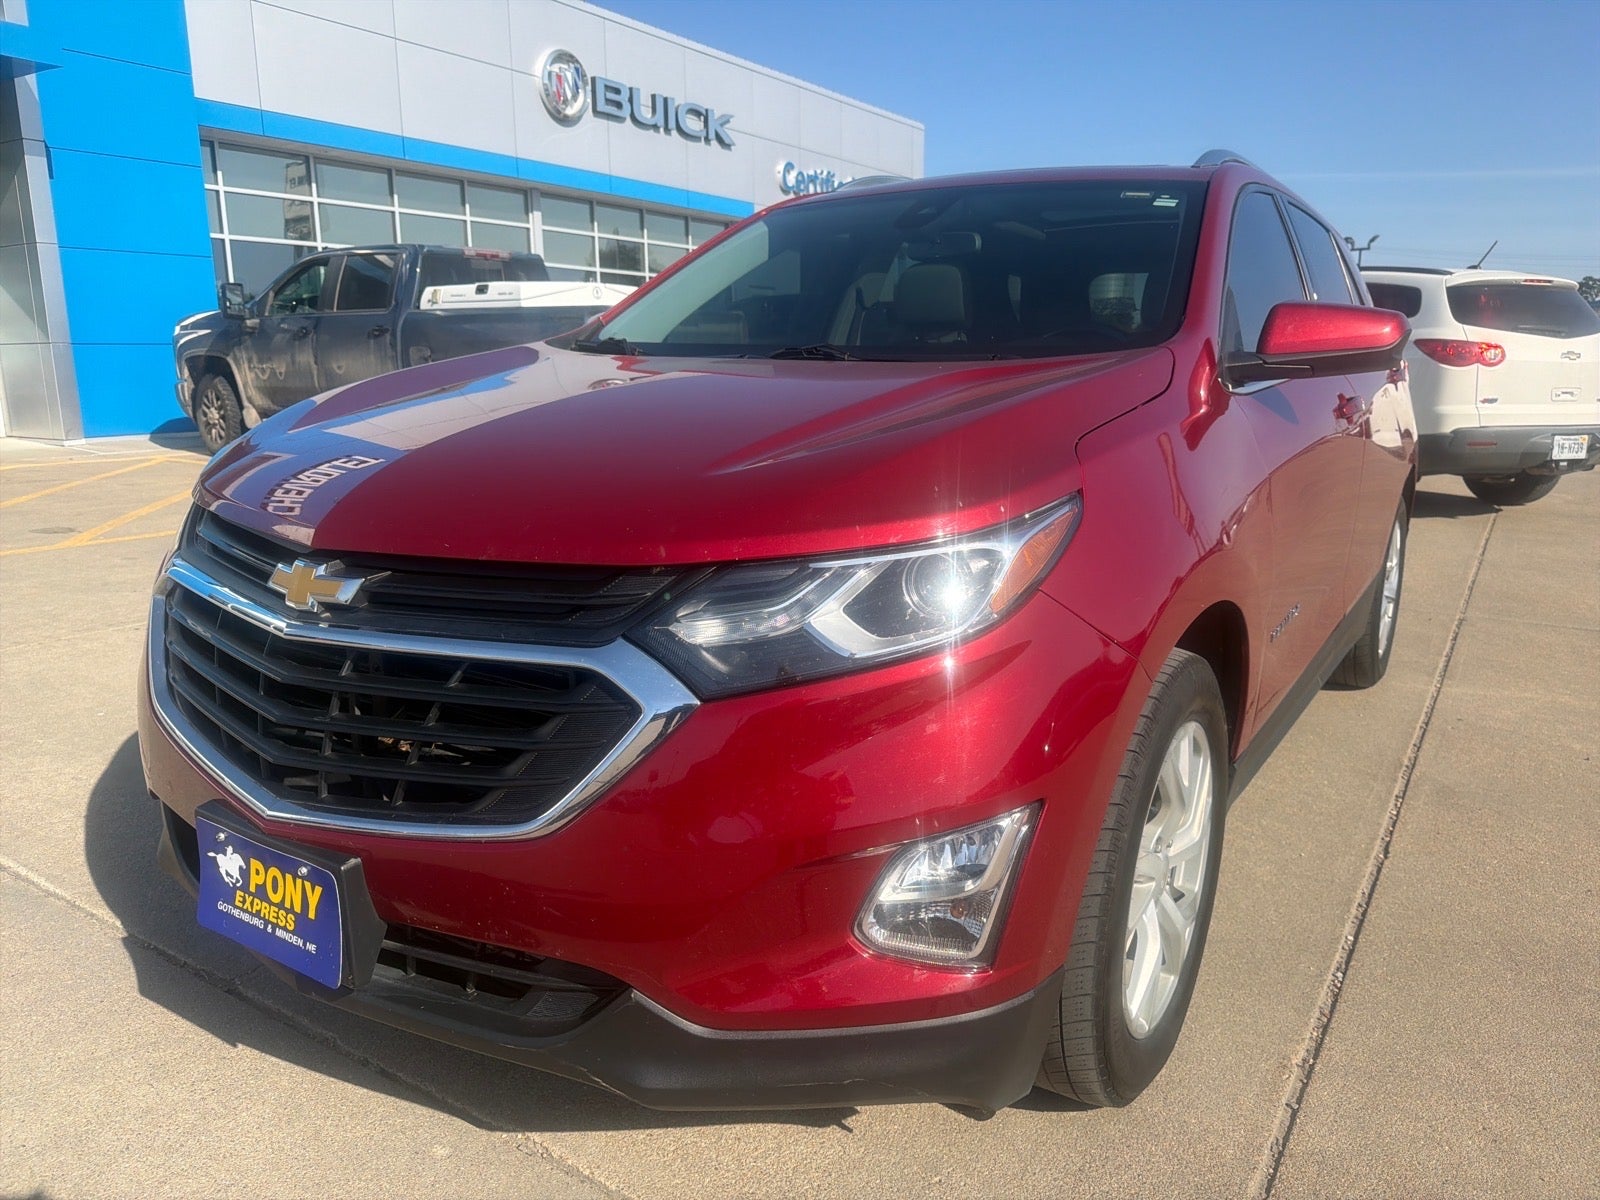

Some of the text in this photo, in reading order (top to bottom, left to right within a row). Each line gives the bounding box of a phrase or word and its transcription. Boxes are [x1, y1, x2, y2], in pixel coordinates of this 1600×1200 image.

[591, 76, 736, 151] BUICK
[234, 890, 295, 931] EXPRESS
[249, 857, 323, 920] PONY
[217, 901, 317, 954] GOTHENBURG & MINDEN, NE
